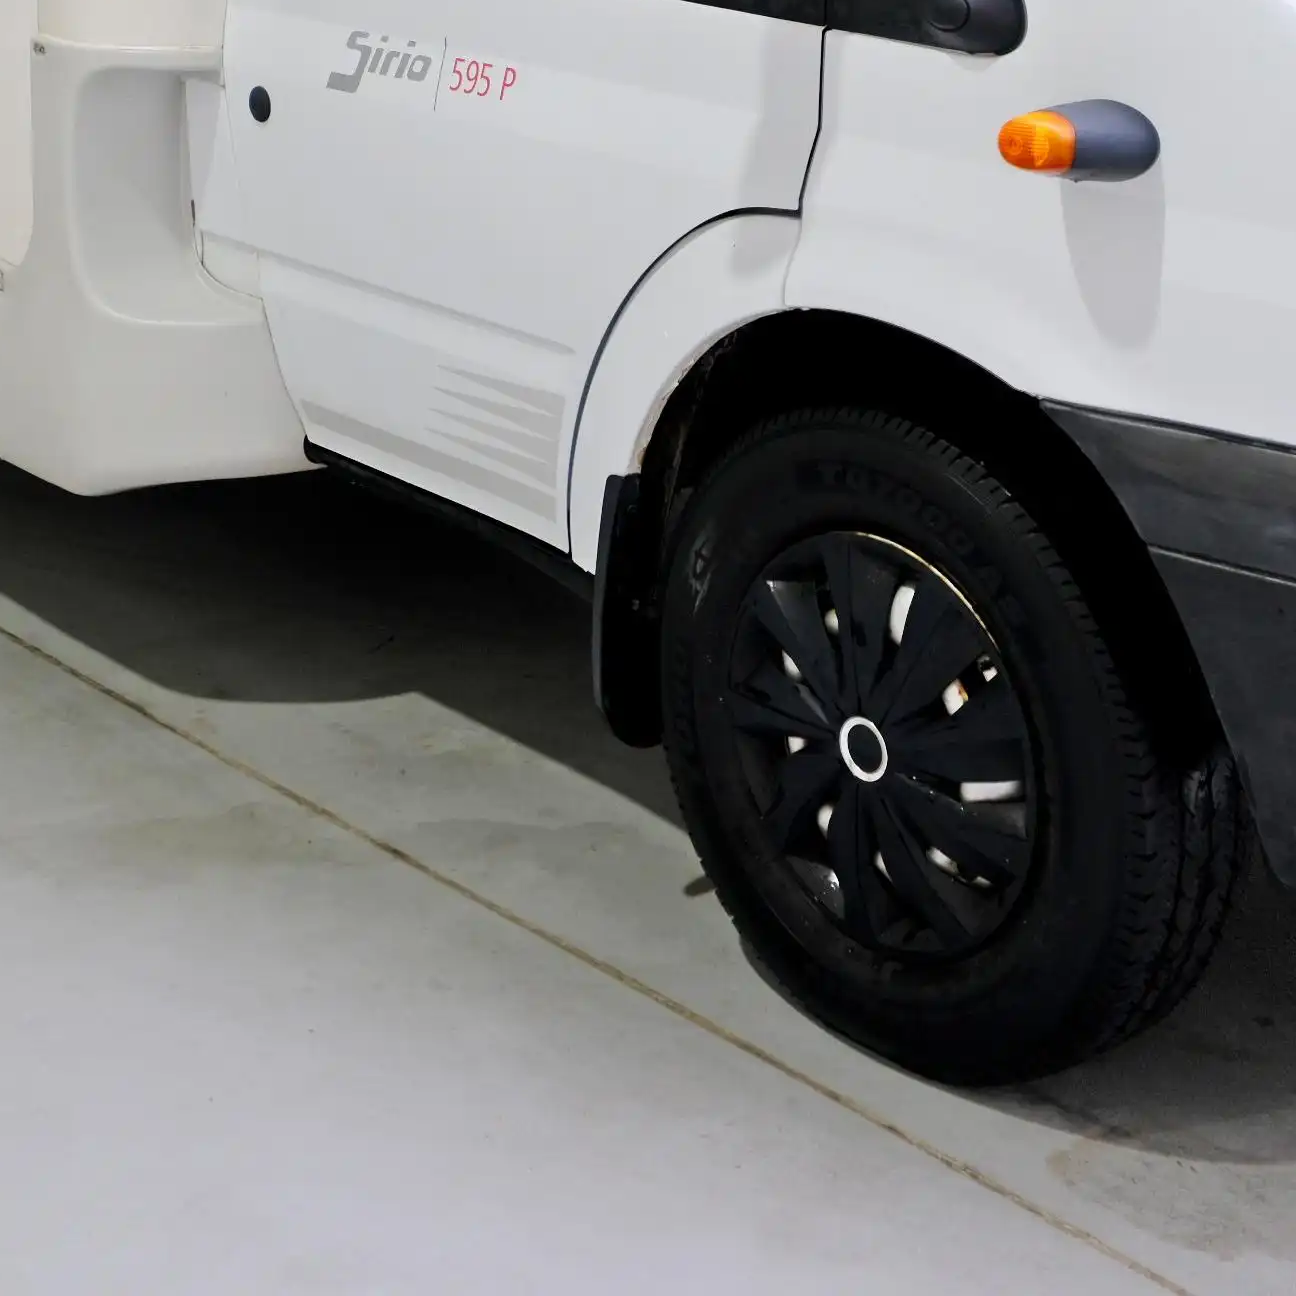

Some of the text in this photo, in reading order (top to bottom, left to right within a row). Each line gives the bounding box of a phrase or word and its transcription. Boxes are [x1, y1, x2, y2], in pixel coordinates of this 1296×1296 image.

[325, 30, 518, 101] Sirio 595 P
